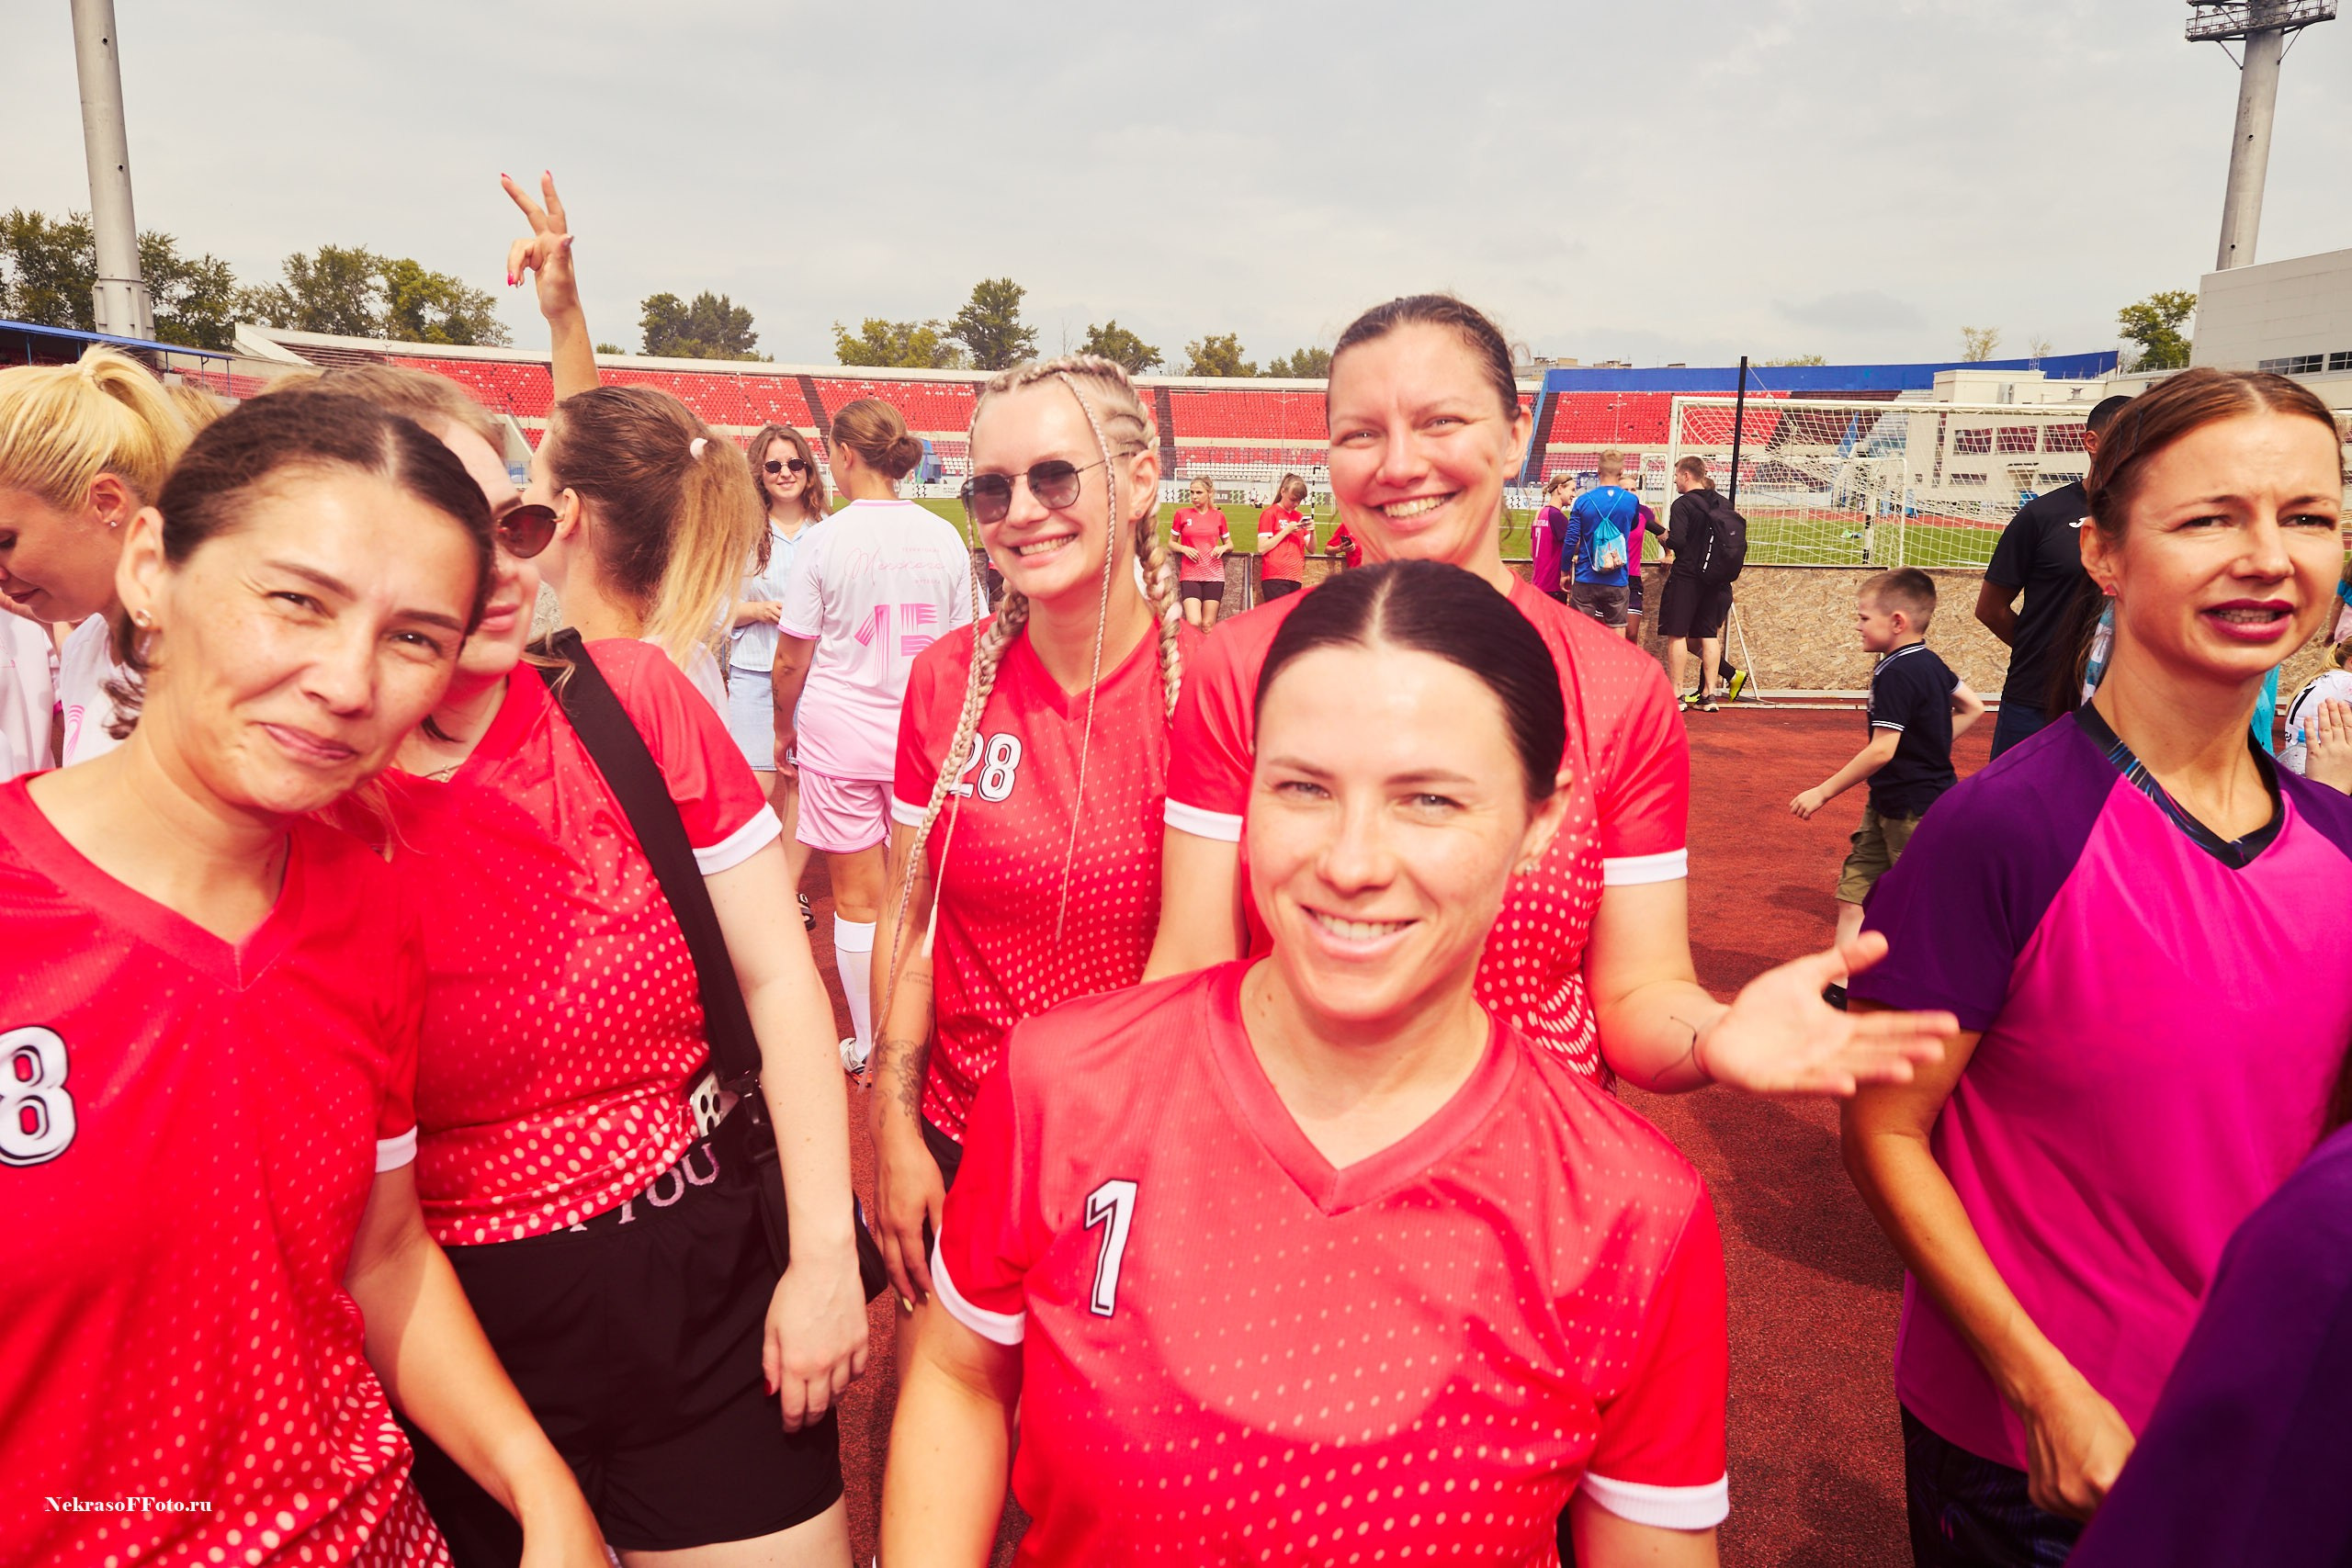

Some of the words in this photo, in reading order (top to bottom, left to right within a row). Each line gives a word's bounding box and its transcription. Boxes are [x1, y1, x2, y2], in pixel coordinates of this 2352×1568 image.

[854, 603, 939, 683] 15
[947, 732, 1023, 803] 28
[0, 1024, 78, 1168] 8
[1083, 1179, 1138, 1318] 1
